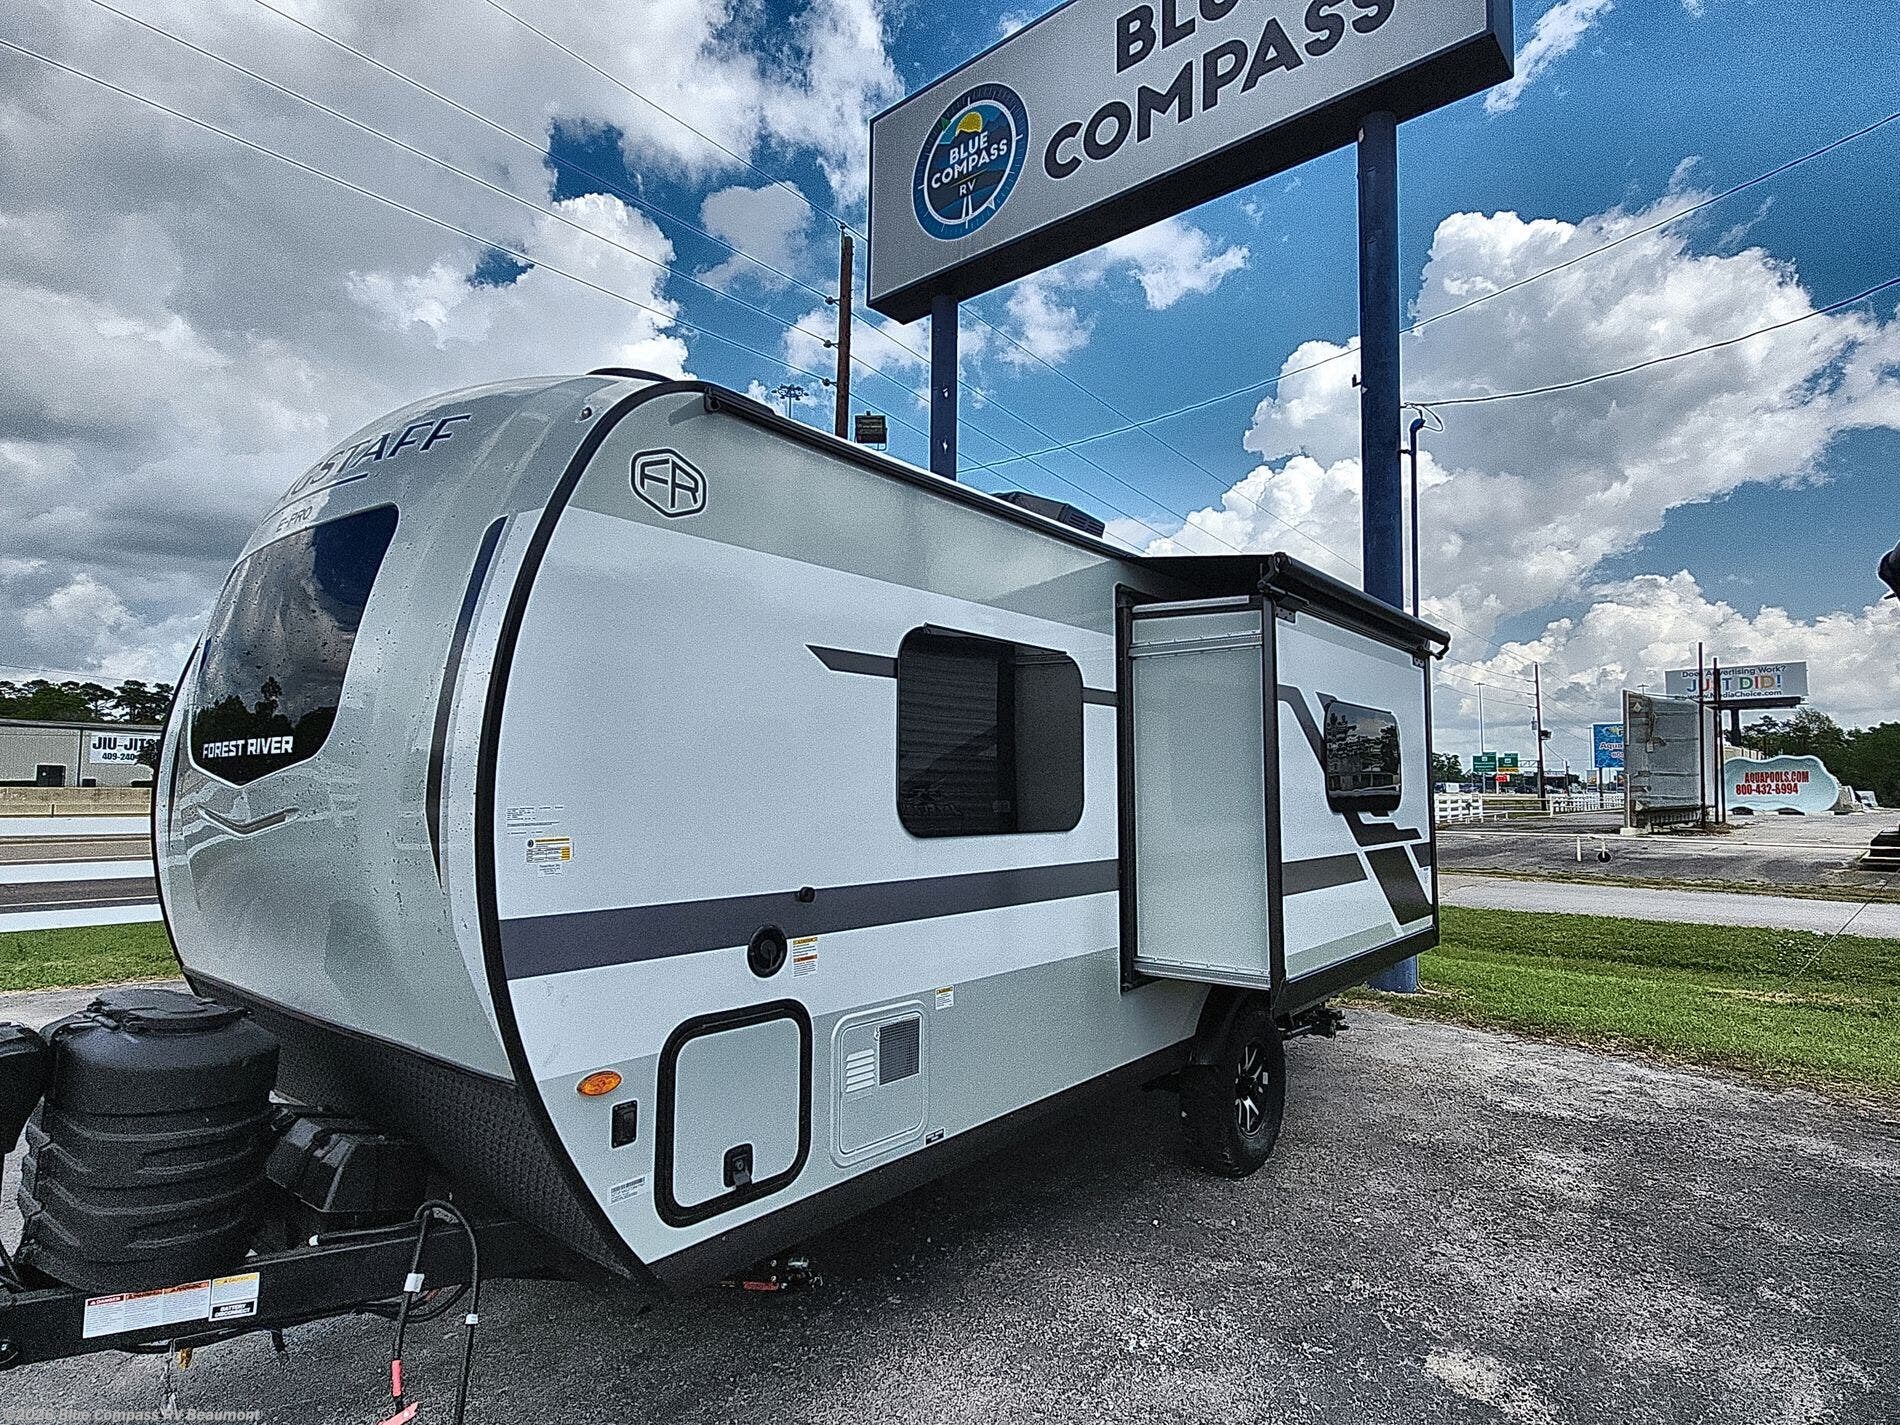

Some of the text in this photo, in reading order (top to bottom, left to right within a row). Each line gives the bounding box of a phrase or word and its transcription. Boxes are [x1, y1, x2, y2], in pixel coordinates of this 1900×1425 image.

[1044, 0, 1396, 181] COMPASS
[949, 131, 989, 165] BLUE
[931, 139, 1008, 189] COMPASS
[959, 179, 977, 197] RV
[1706, 667, 1756, 677] Avertising
[1758, 665, 1786, 673] Work?
[1686, 674, 1781, 692] JUT DID!
[92, 737, 160, 751] JIU-JITS
[203, 736, 294, 758] FOREST RIVER
[1744, 771, 1809, 783] AQUAPOOLS.COM
